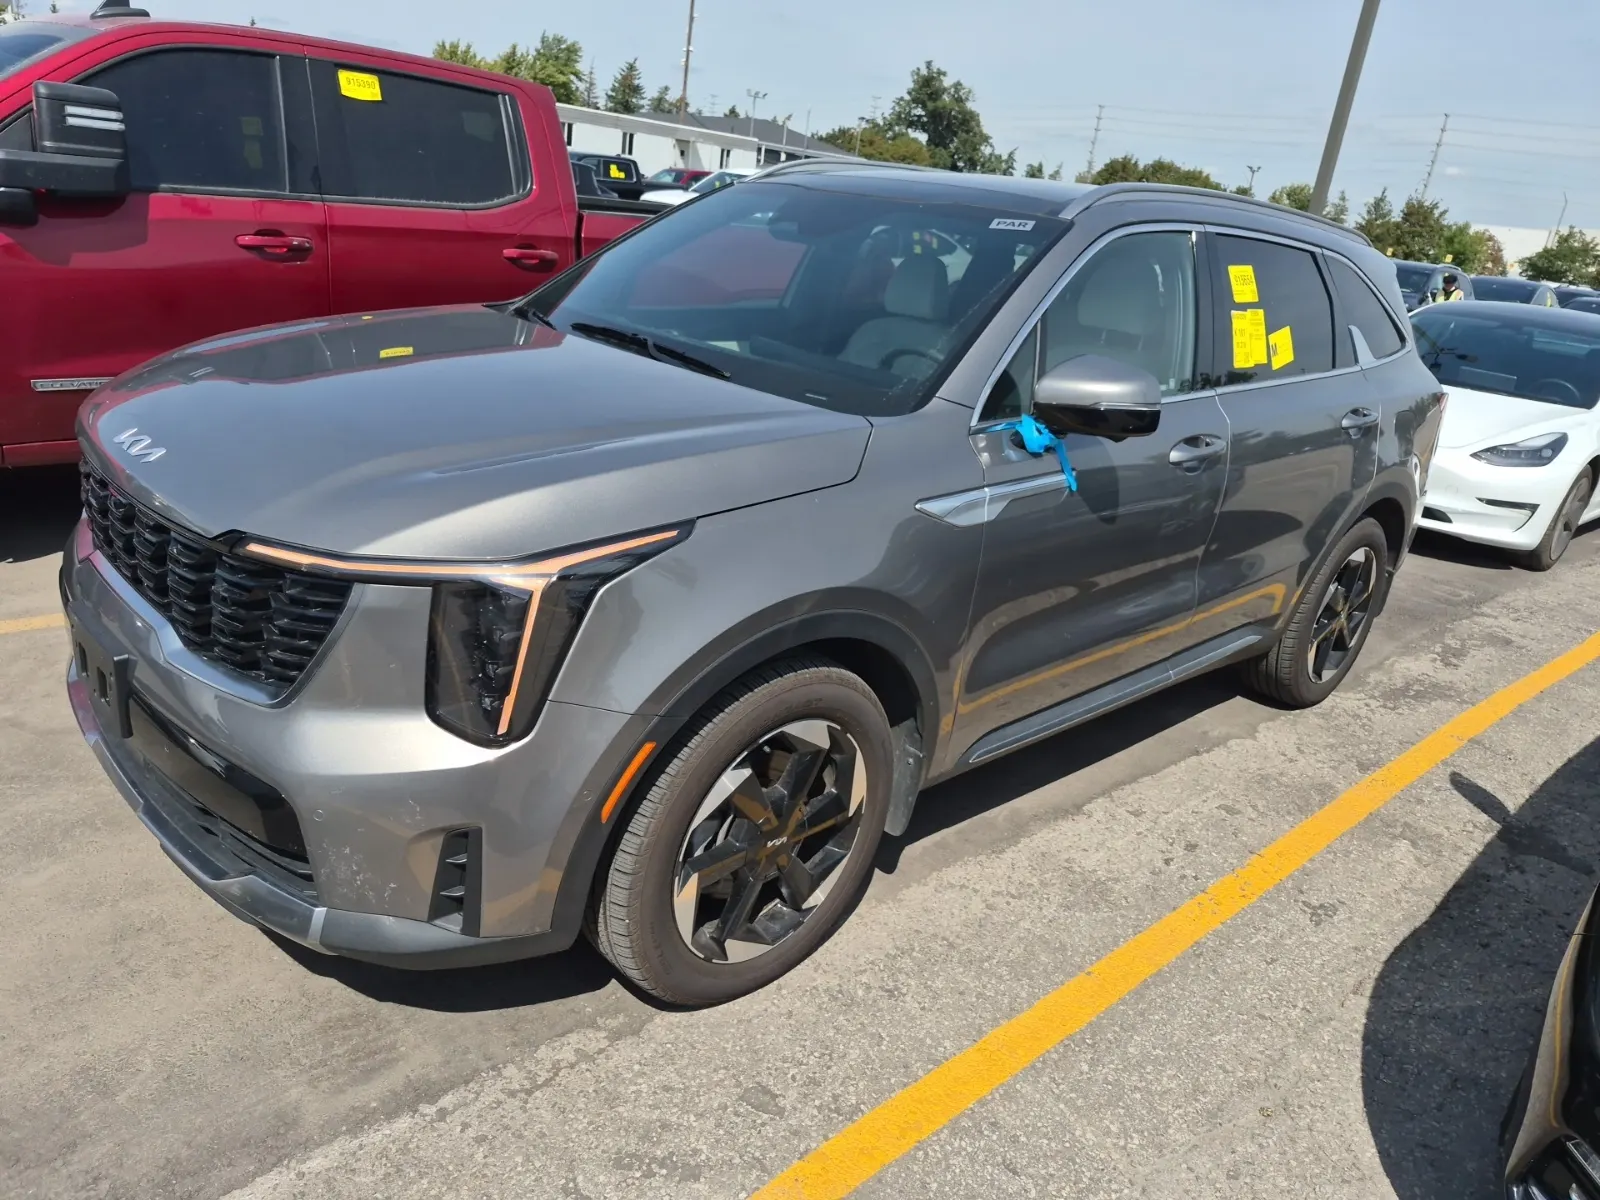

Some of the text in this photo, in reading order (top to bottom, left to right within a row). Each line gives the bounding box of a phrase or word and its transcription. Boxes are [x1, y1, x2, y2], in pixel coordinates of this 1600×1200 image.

[346, 76, 376, 90] 915390
[995, 220, 1029, 229] PAR
[1271, 342, 1279, 358] M
[113, 427, 167, 463] KIA
[766, 836, 788, 848] KIA
